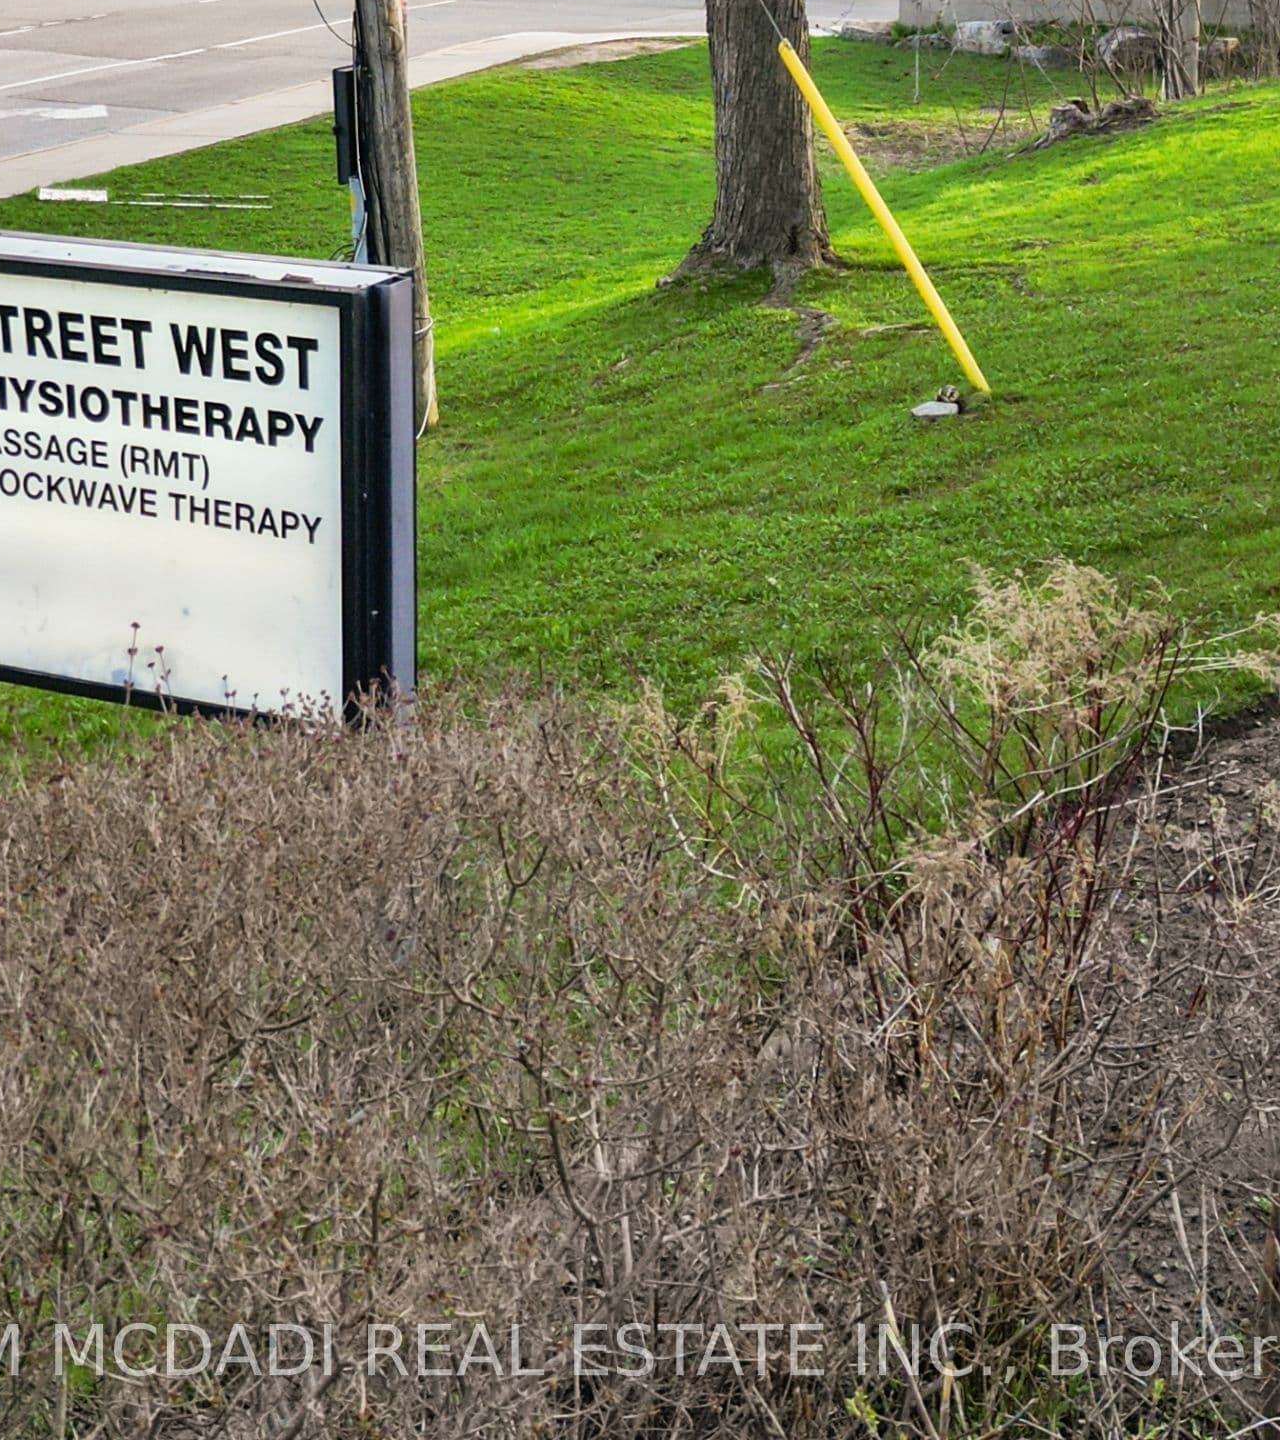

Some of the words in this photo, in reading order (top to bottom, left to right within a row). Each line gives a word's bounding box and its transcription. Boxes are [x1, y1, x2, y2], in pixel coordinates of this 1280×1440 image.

[169, 321, 320, 391] WEST
[120, 443, 211, 490] (RMT)
[167, 492, 323, 545] THERAPY
